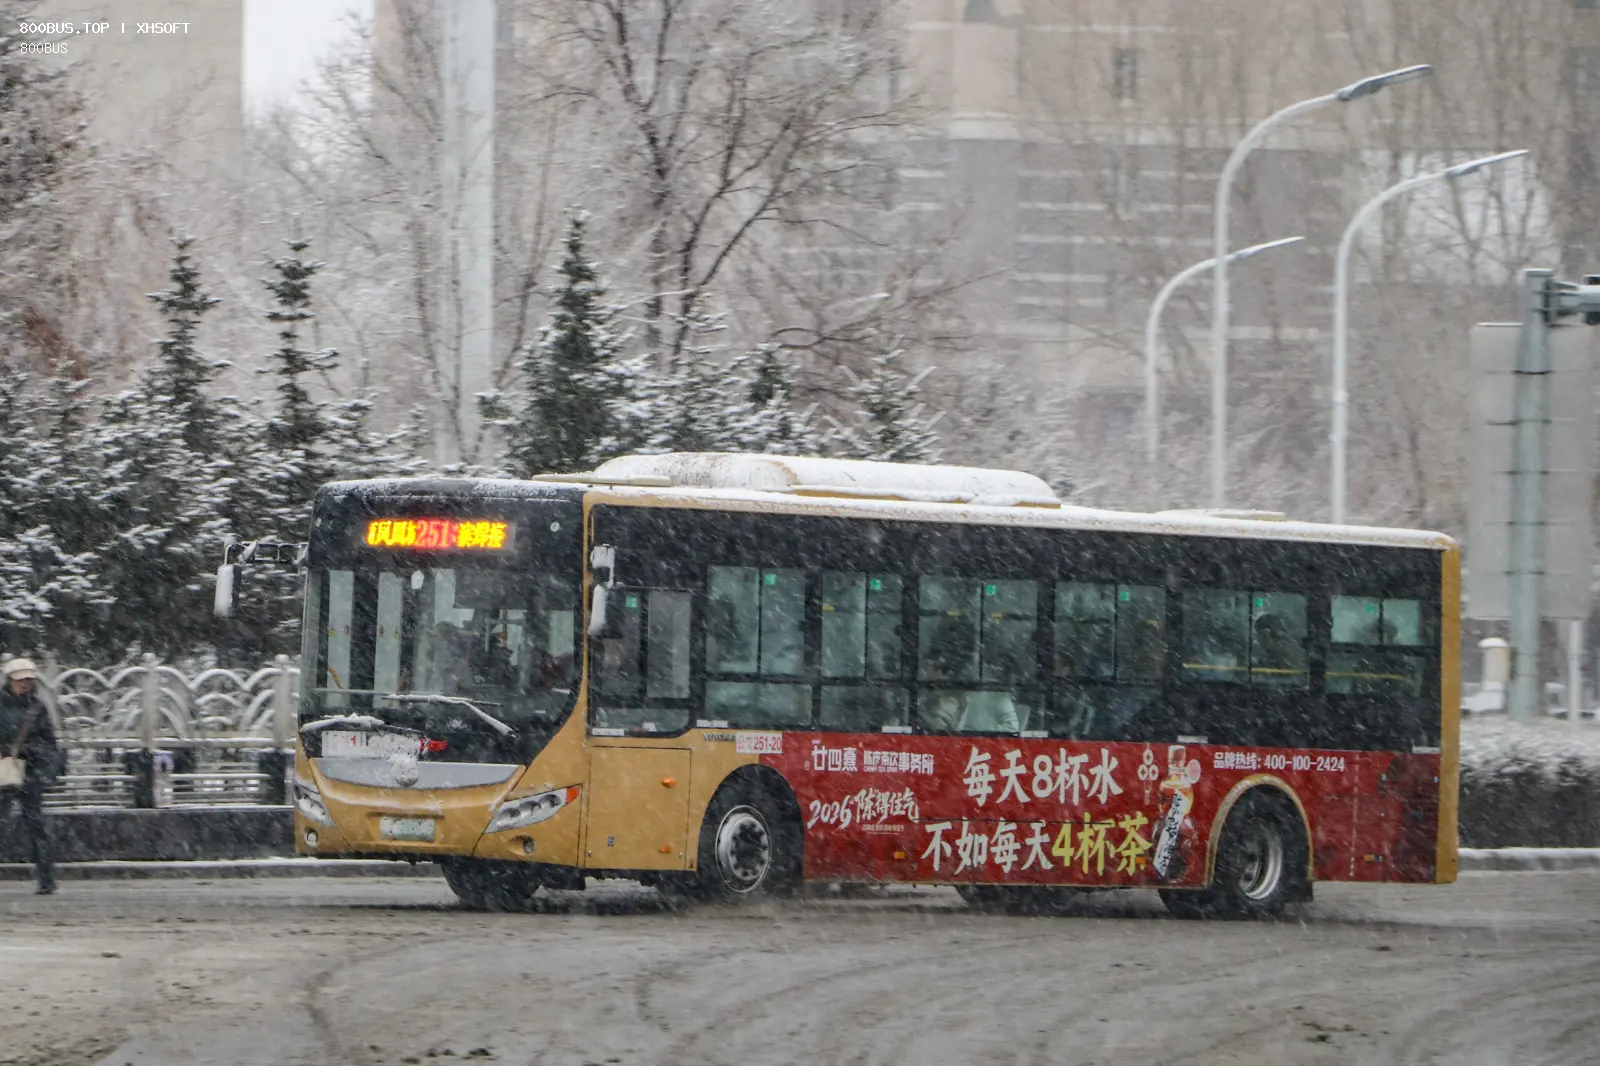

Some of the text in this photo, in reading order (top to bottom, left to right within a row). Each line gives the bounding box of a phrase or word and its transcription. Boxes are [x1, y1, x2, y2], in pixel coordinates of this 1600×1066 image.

[963, 746, 1123, 806] 每天8杯水
[1263, 754, 1345, 771] 400-100-2424
[921, 811, 1152, 877] 不如每天4杯茶
